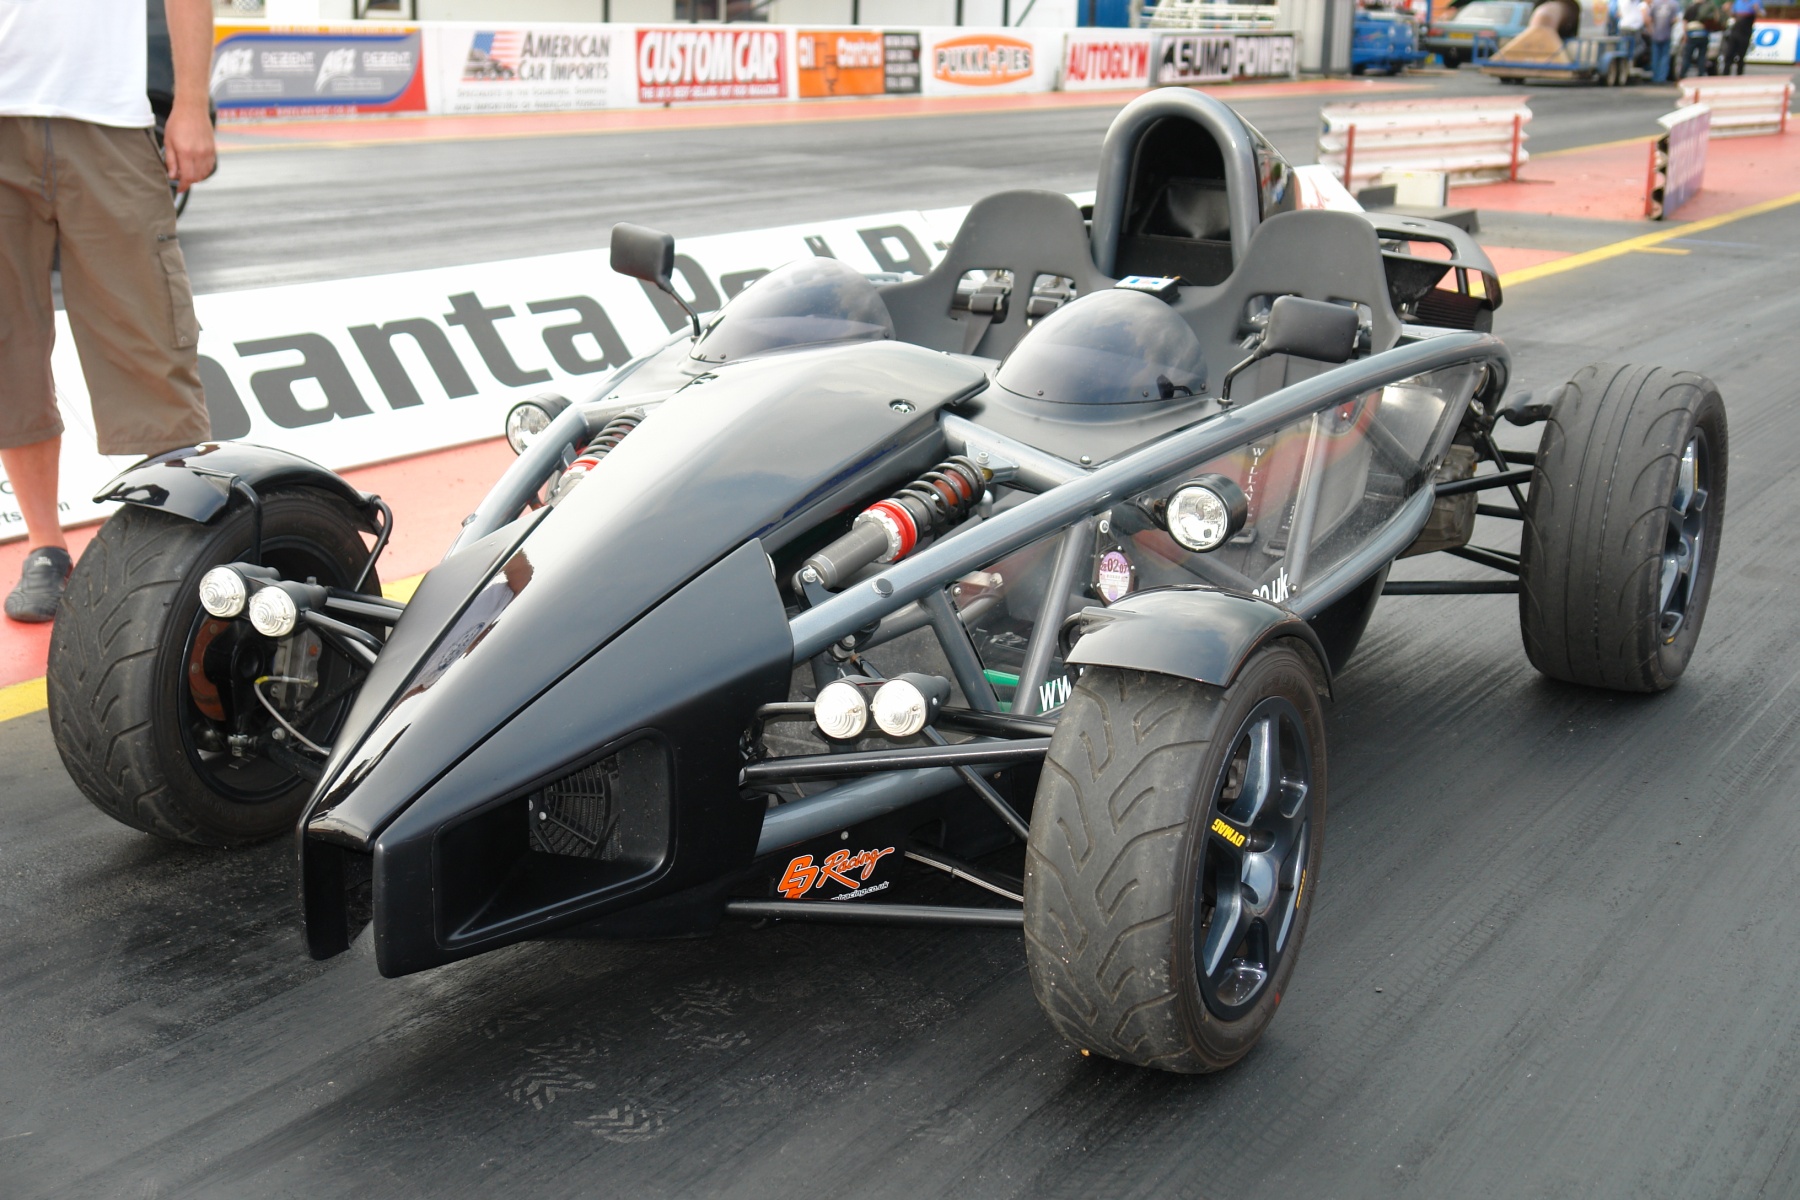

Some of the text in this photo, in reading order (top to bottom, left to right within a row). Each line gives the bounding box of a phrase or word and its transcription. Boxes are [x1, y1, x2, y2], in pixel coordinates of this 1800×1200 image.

[521, 31, 610, 58] AMERICAN
[837, 36, 882, 68] Control
[1174, 36, 1294, 77] SUMO POWER
[517, 59, 609, 81] CAR IMPORTS
[1067, 42, 1149, 81] AUTOGLYM
[1211, 818, 1246, 848] DYMAG
[815, 847, 895, 888] Racing
